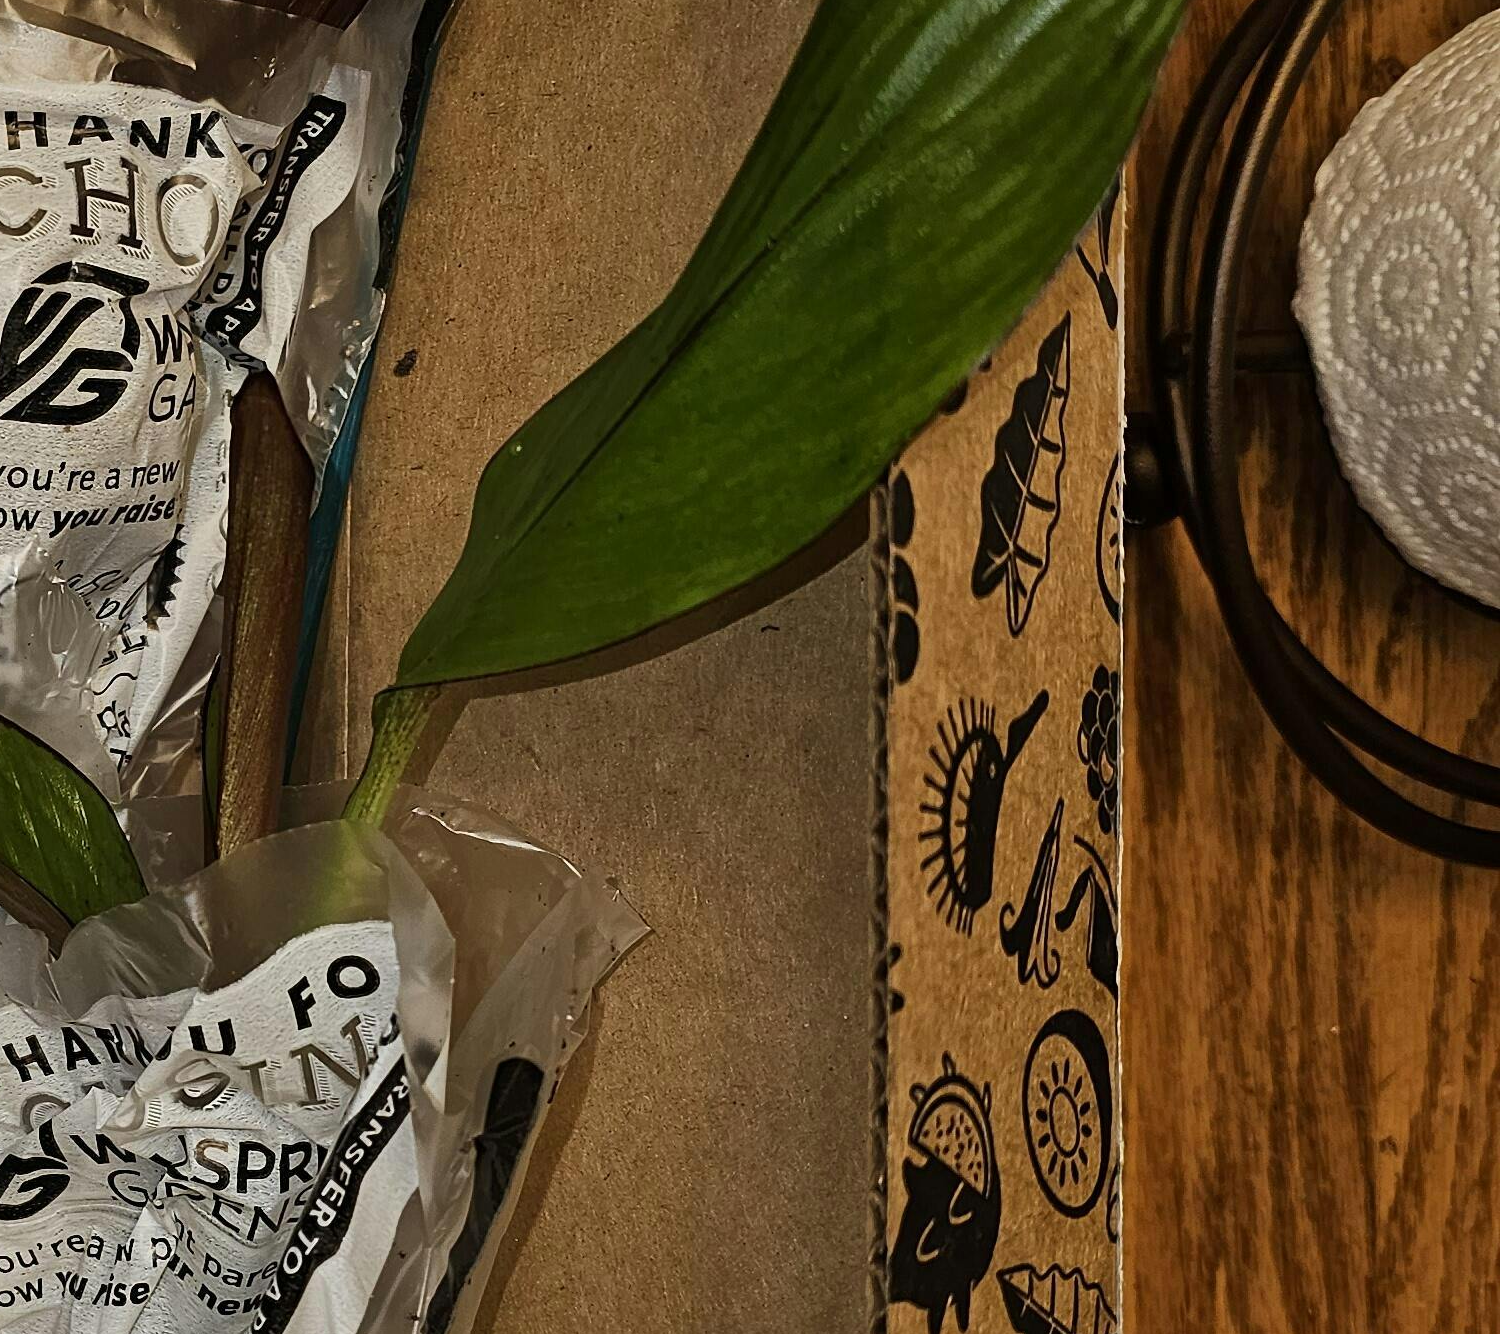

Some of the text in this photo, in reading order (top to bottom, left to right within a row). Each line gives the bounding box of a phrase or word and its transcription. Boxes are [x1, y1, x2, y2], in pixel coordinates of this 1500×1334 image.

[250, 108, 335, 243] TRANSFER
[248, 251, 260, 292] TO
[104, 466, 122, 490] a
[130, 459, 181, 489] new
[48, 508, 109, 539] you
[106, 493, 177, 527] raise
[282, 1230, 320, 1275] TO
